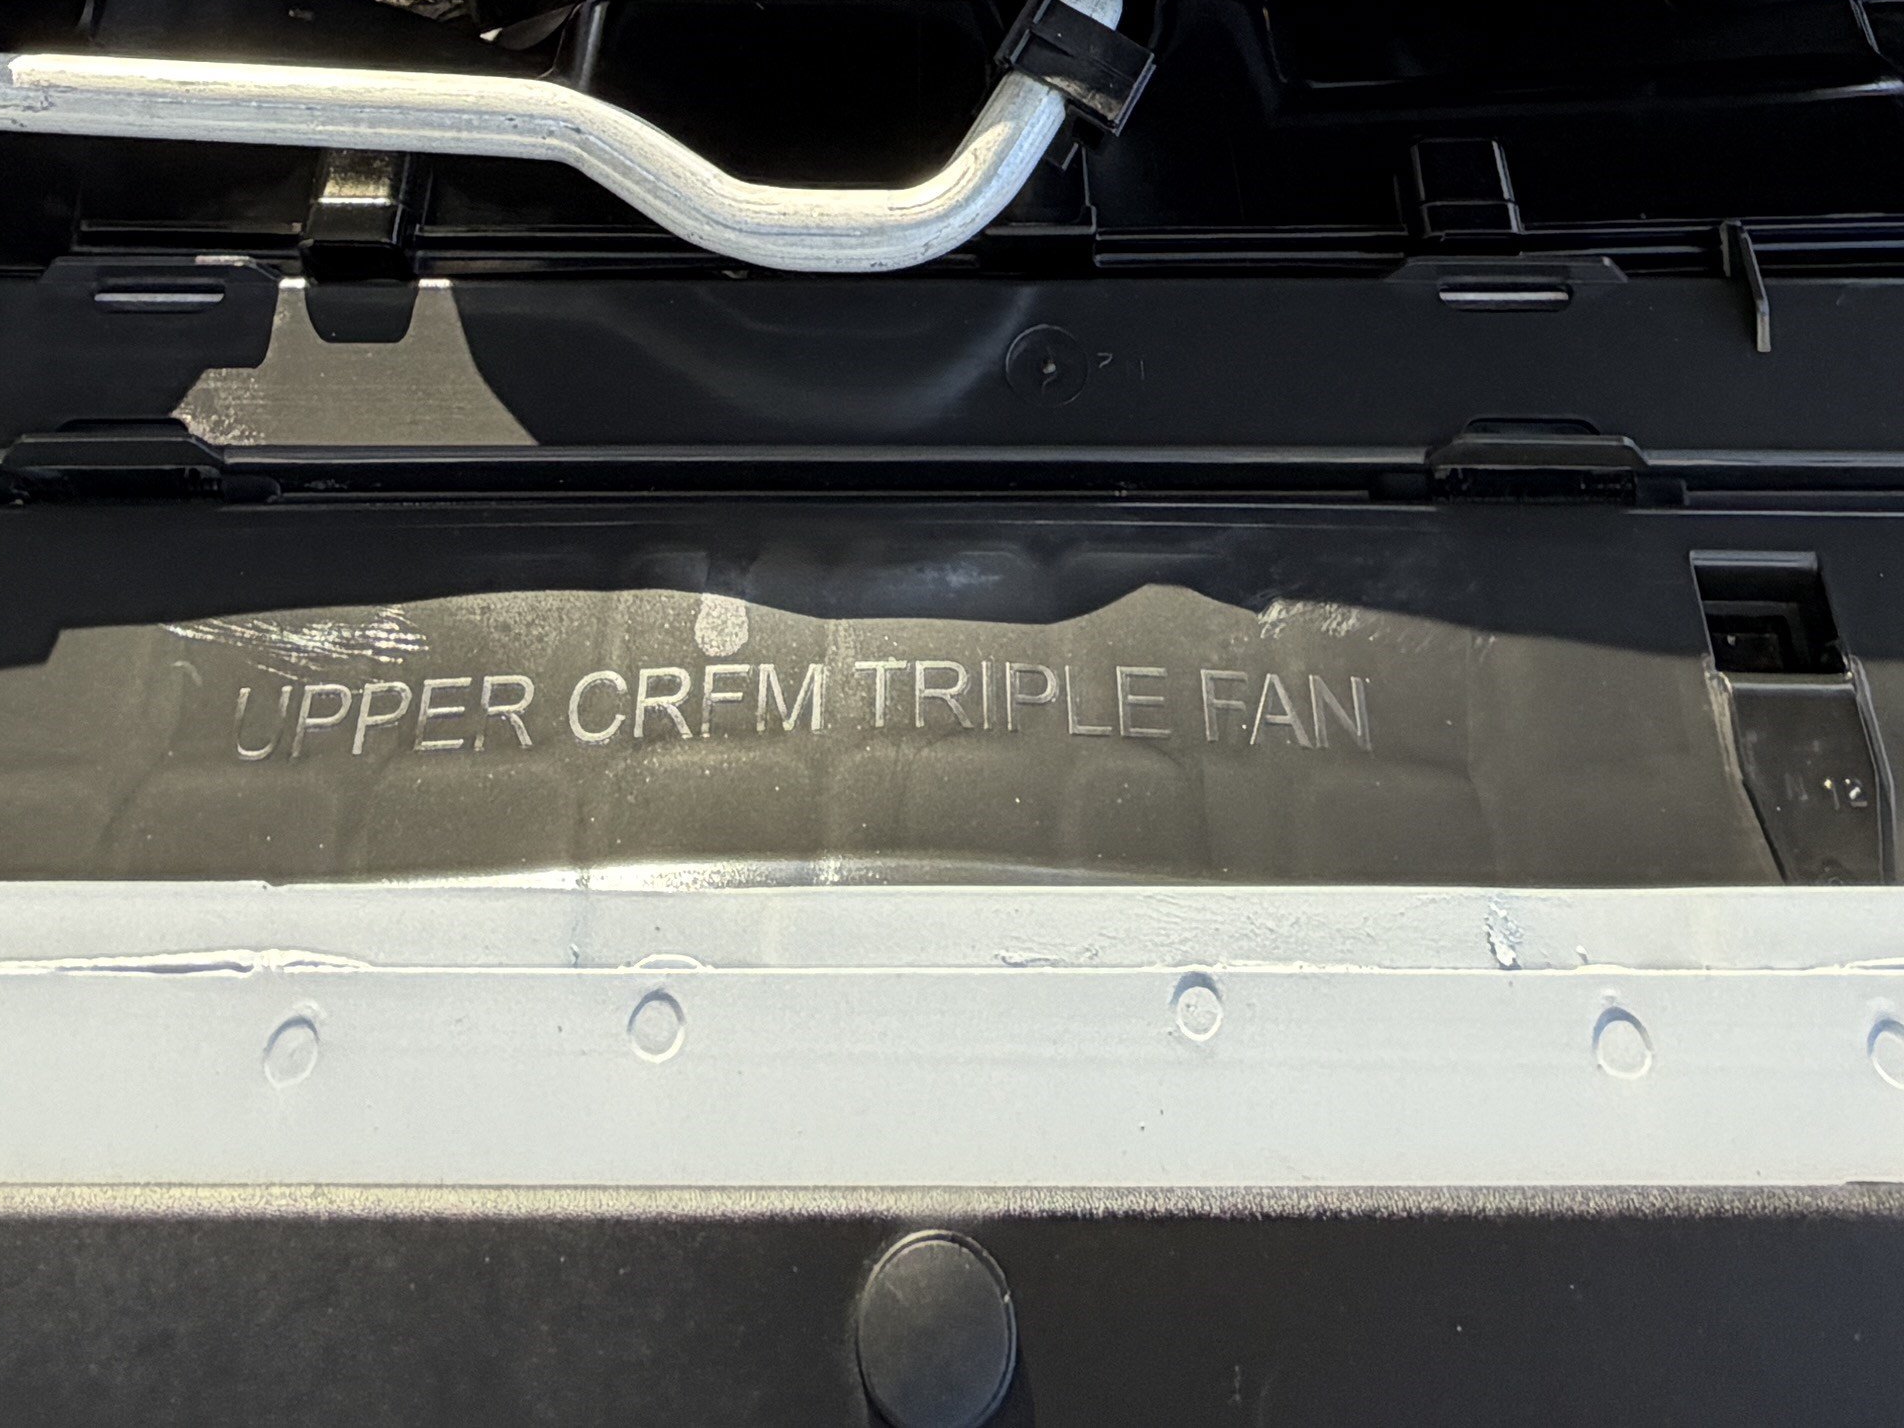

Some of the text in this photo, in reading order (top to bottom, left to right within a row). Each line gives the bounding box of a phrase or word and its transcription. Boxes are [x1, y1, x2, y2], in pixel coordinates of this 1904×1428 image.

[234, 675, 537, 761] UPPER
[854, 657, 1174, 738] TRIPLE
[1200, 670, 1373, 751] FAN
